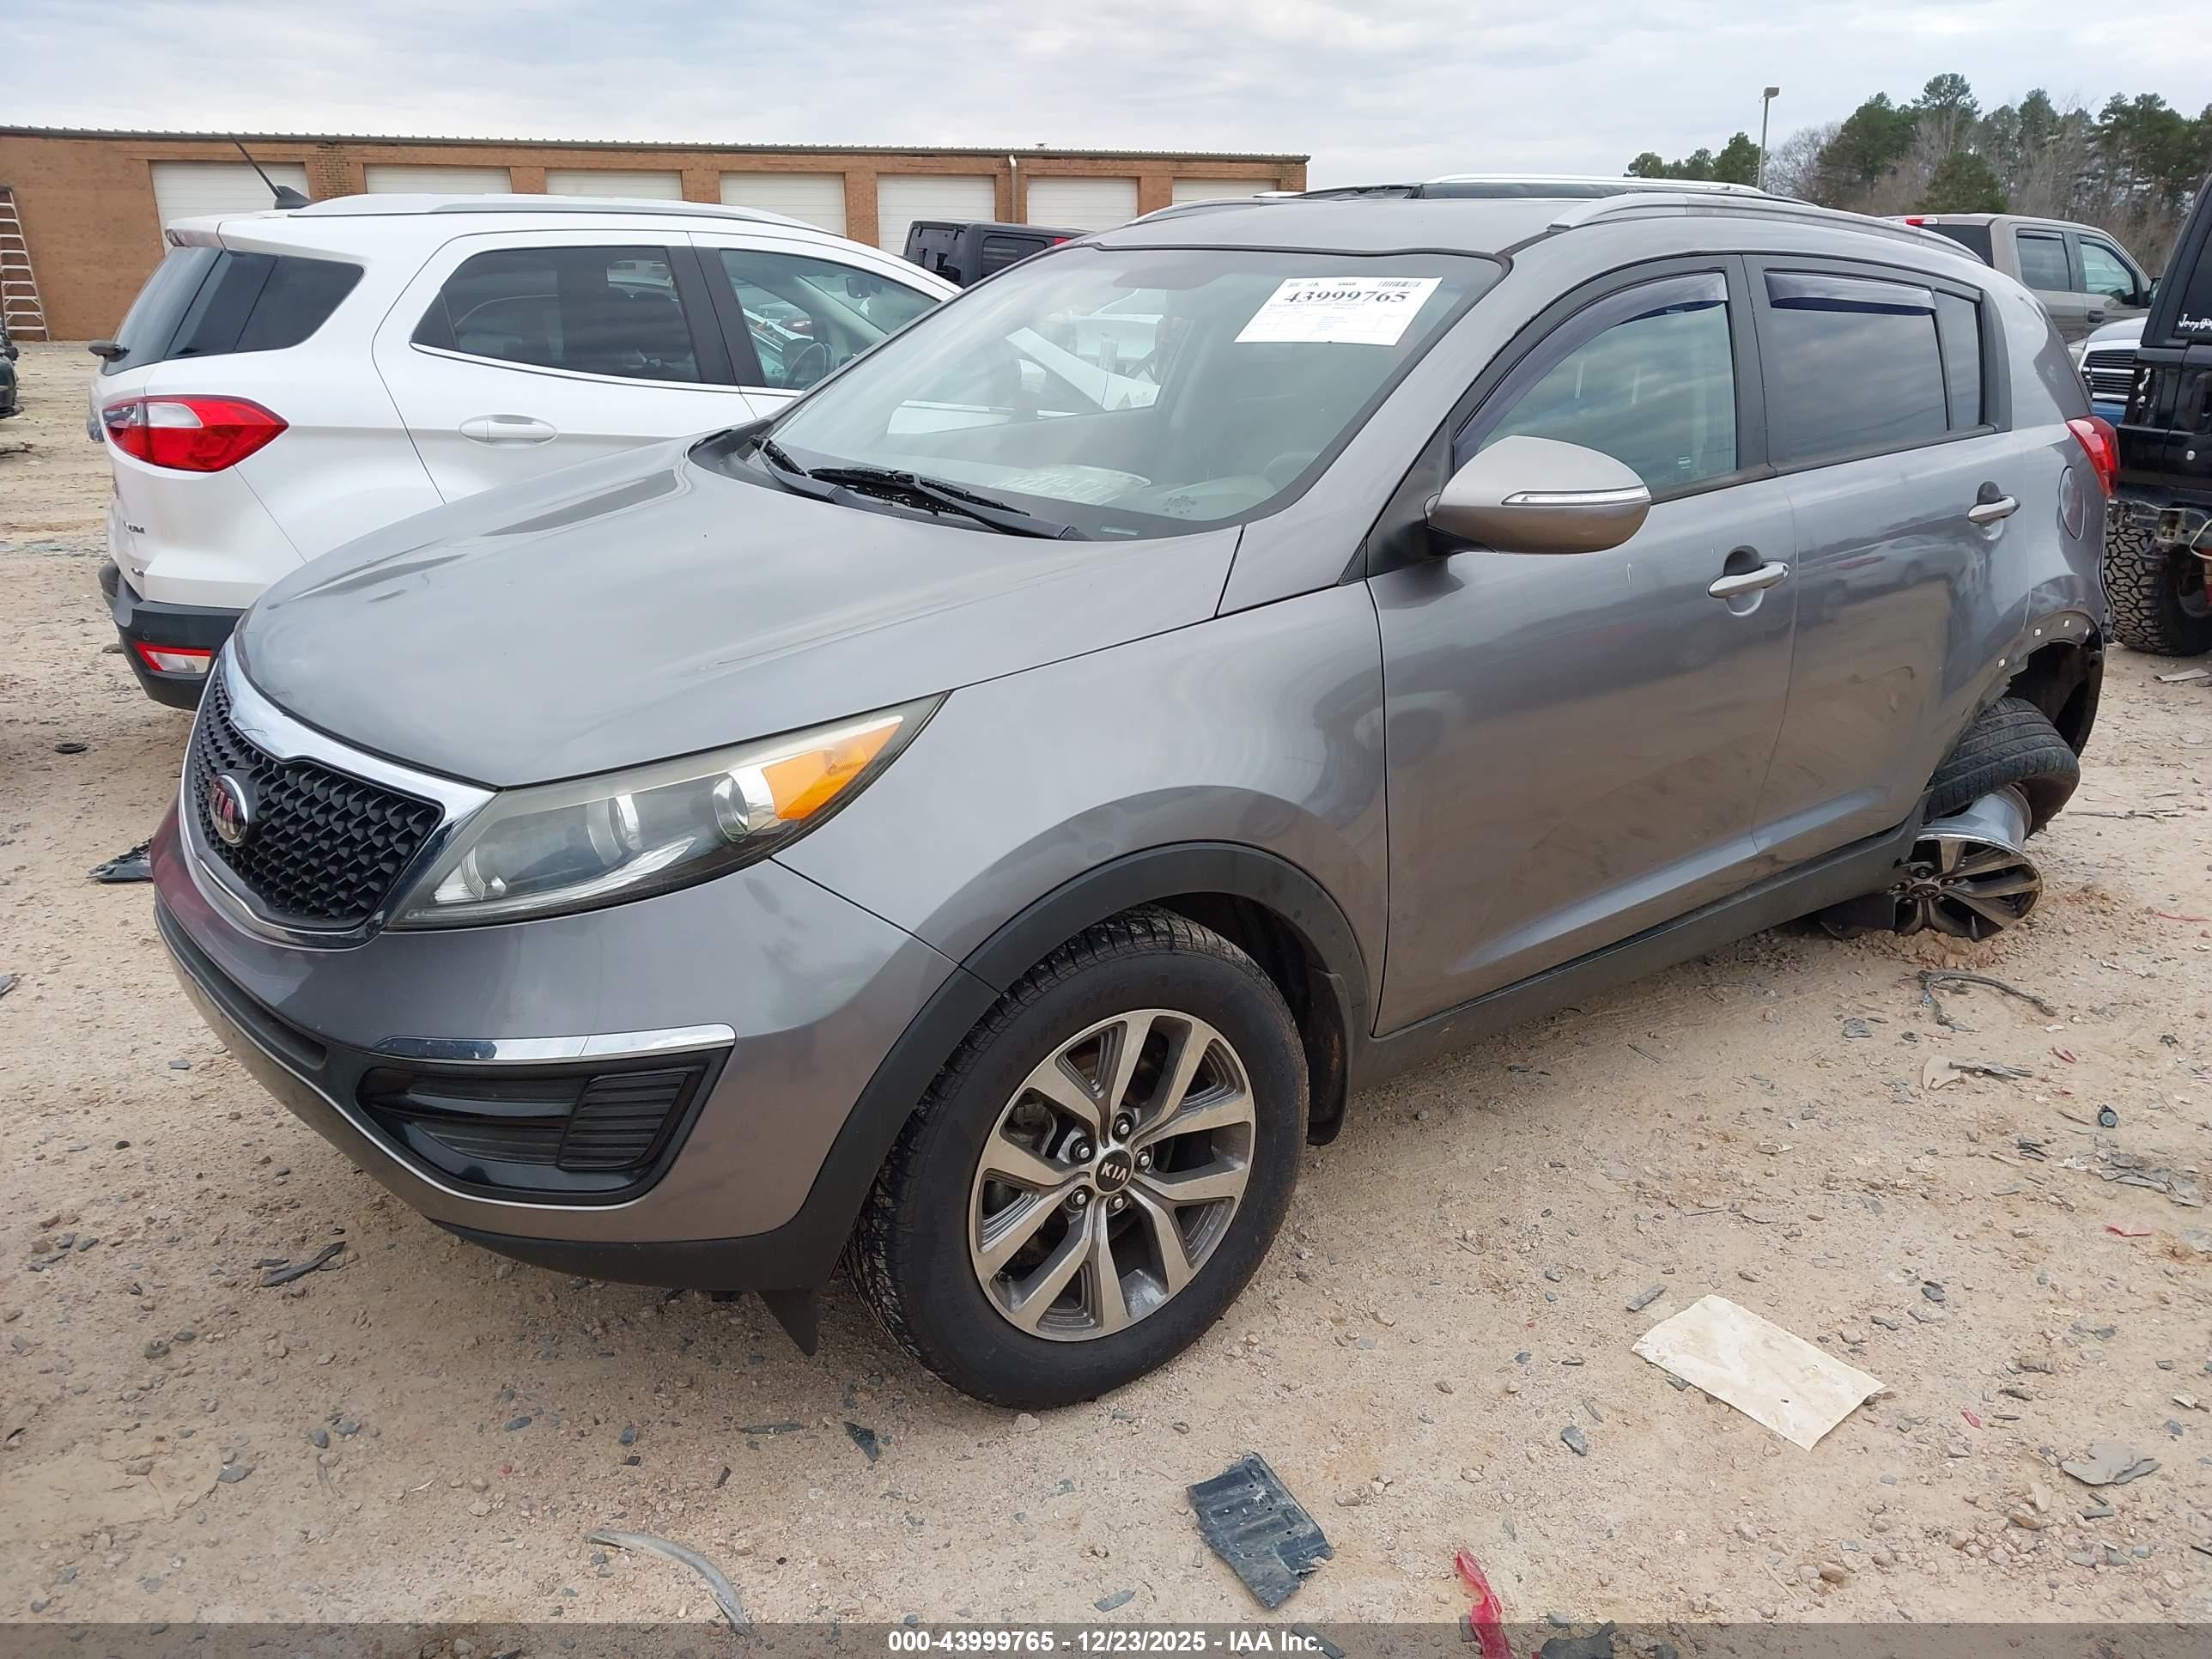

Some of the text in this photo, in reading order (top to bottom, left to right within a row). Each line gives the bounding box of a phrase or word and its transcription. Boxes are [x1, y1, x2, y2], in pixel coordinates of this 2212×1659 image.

[1284, 289, 1411, 303] 43999765
[2178, 313, 2200, 332] Jeep
[1100, 1161, 1127, 1182] KIA
